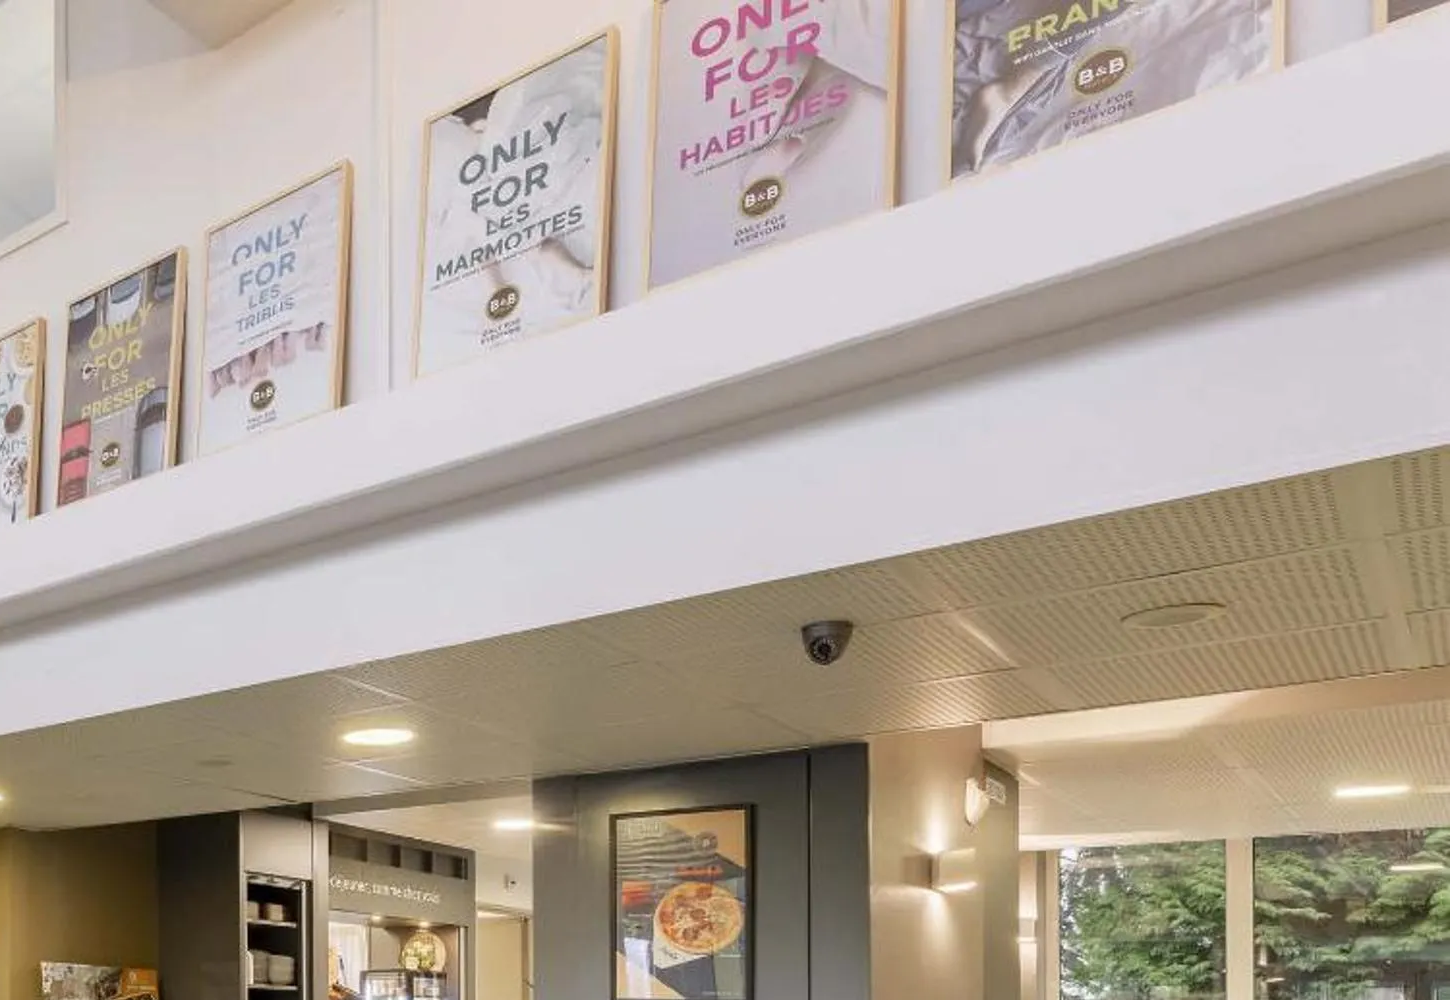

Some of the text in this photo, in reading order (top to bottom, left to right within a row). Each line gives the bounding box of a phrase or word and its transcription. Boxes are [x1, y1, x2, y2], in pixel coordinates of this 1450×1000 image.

[691, 0, 825, 57] ONL
[705, 22, 820, 102] FOR
[1079, 57, 1125, 87] B&B
[730, 77, 794, 118] LES
[459, 112, 567, 185] ONLY
[471, 162, 548, 213] FOR
[745, 185, 778, 208] B&B
[232, 213, 307, 266] ONLY
[486, 203, 530, 236] LES
[436, 205, 583, 281] MARMOTTES
[239, 251, 296, 295] FOR
[236, 297, 296, 332] TRIBUS
[249, 284, 280, 309] LES
[89, 303, 153, 348] ONLY
[95, 340, 142, 370] FOR
[102, 368, 129, 391] LES
